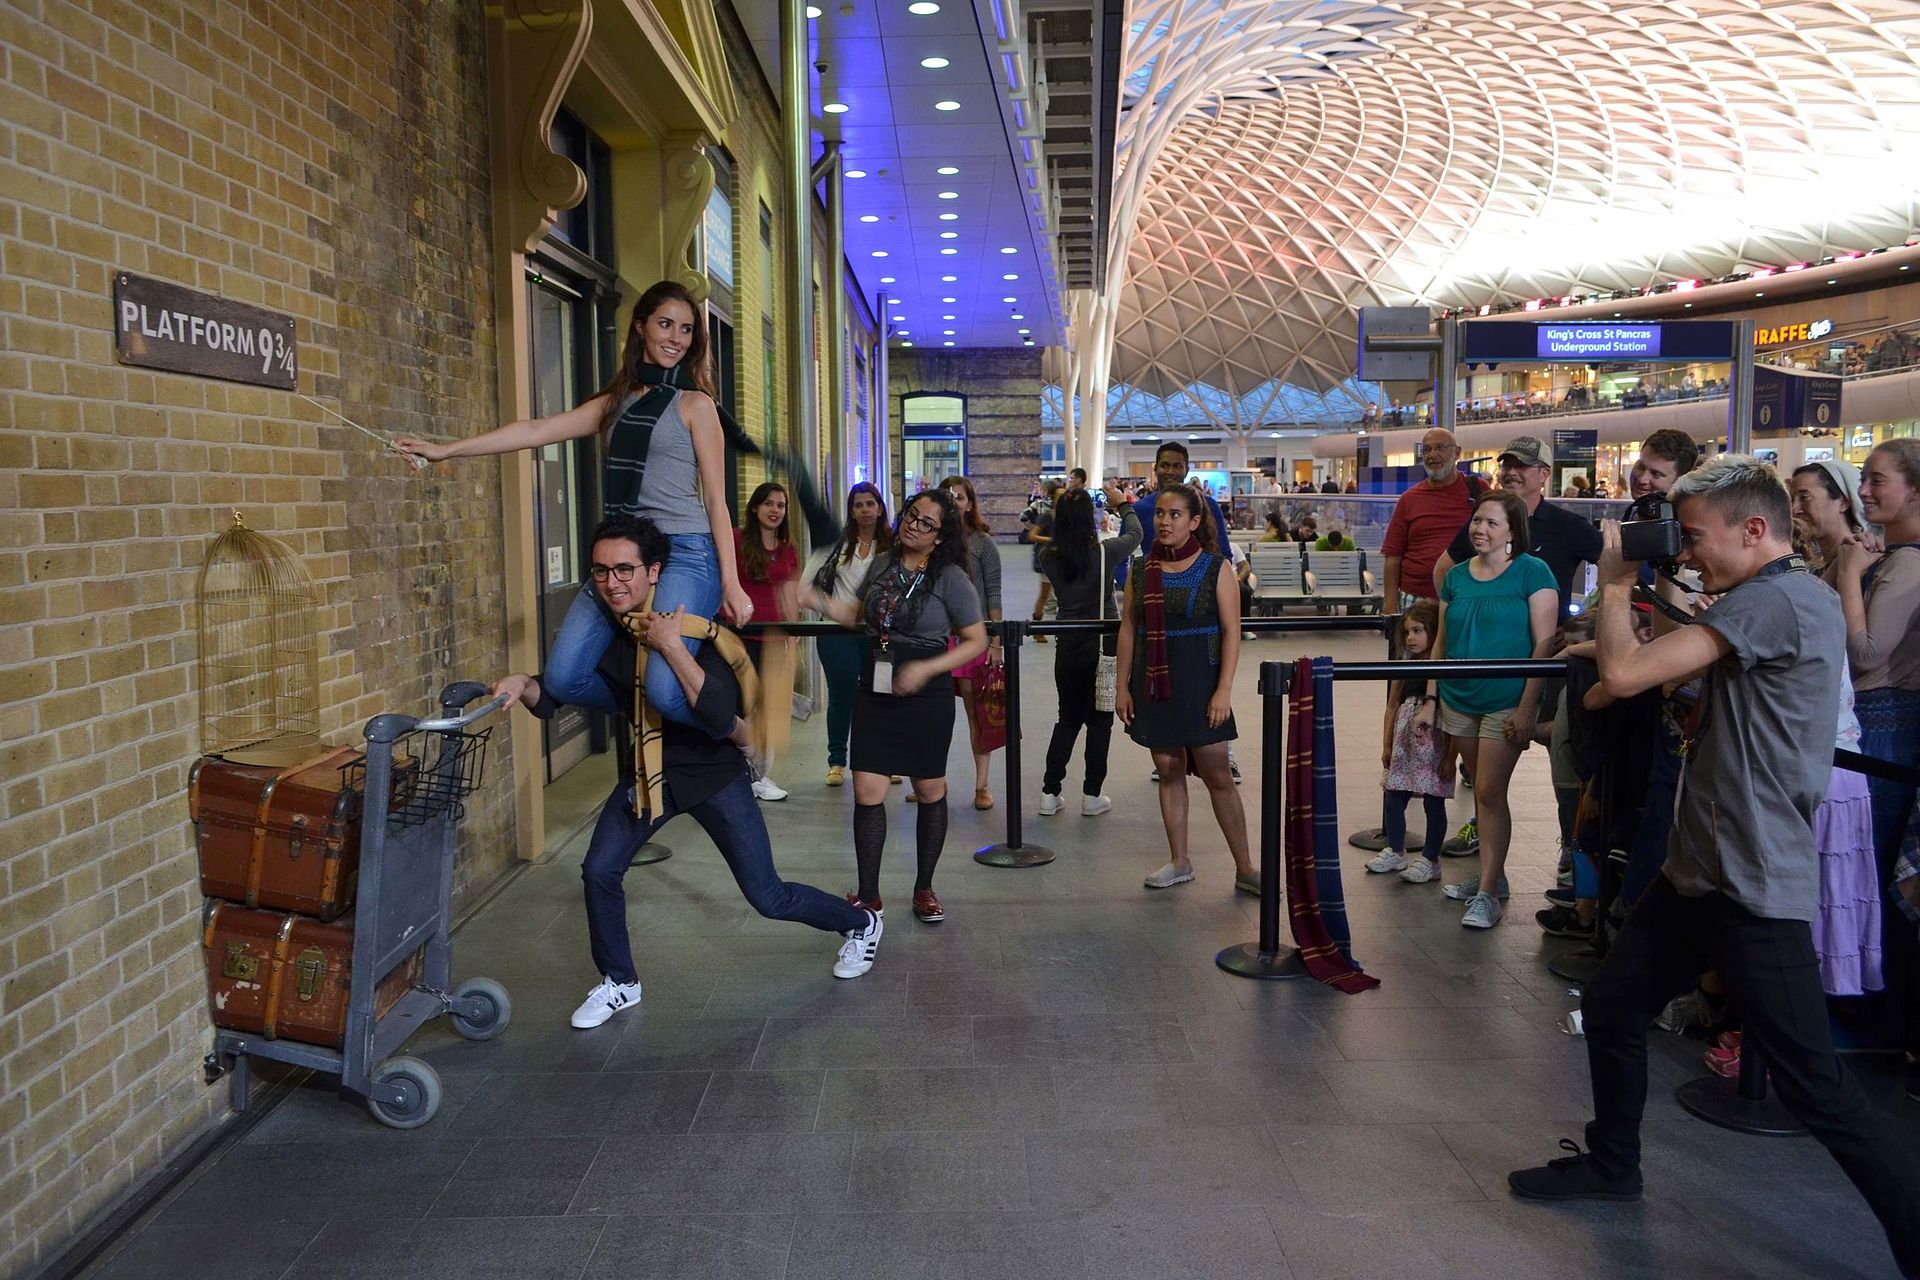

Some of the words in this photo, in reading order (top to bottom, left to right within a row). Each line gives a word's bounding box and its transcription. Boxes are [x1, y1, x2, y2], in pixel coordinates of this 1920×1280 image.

[121, 300, 255, 356] PLATFORM
[1547, 329, 1574, 341] King's
[1575, 329, 1602, 339] Cross
[1603, 329, 1614, 339] St
[1615, 329, 1652, 339] Pancras
[1753, 323, 1808, 346] IRAFFE
[1551, 342, 1612, 353] Underground
[1613, 342, 1647, 352] Station
